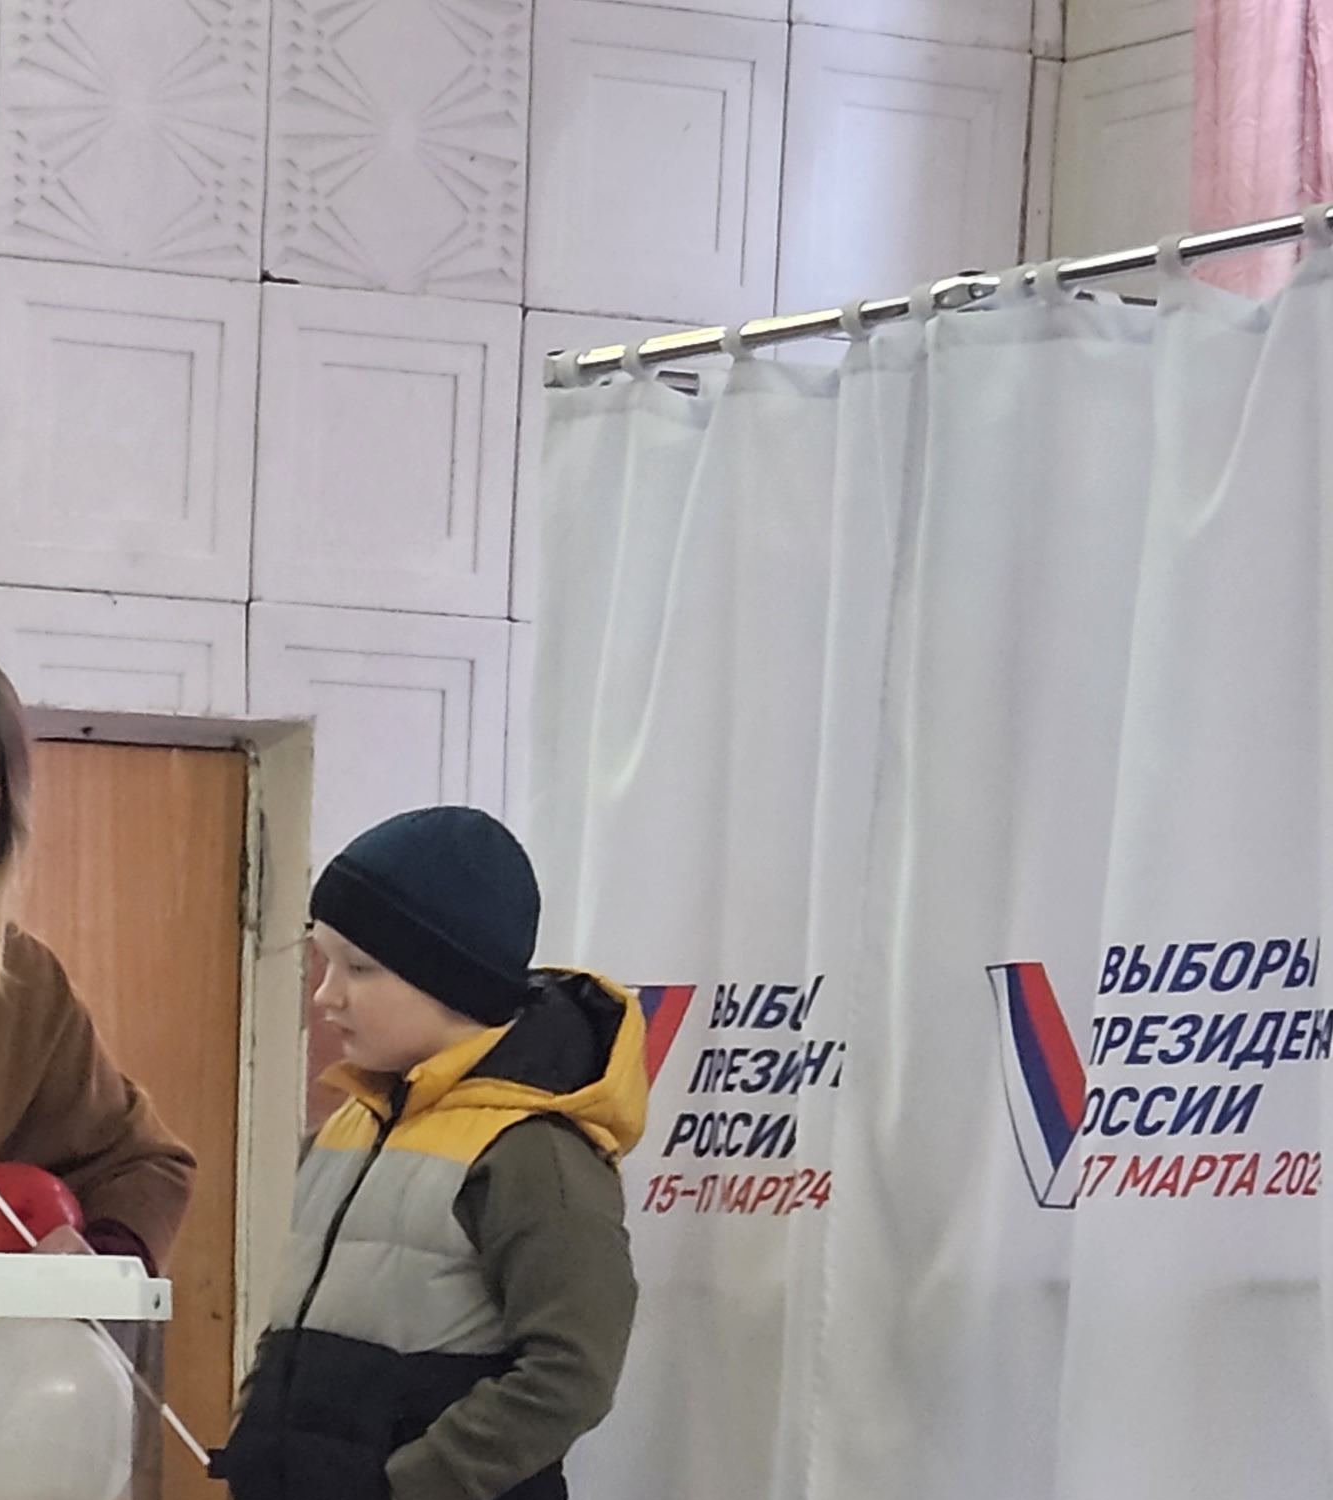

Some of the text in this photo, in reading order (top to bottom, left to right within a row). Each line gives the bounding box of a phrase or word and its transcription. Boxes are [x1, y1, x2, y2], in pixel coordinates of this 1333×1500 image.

[1098, 937, 1321, 995] ВЫБОРЫ
[1082, 1083, 1264, 1136] ОССИИ
[1114, 1152, 1261, 1197] МАРТА
[1263, 1150, 1322, 1195] 202
